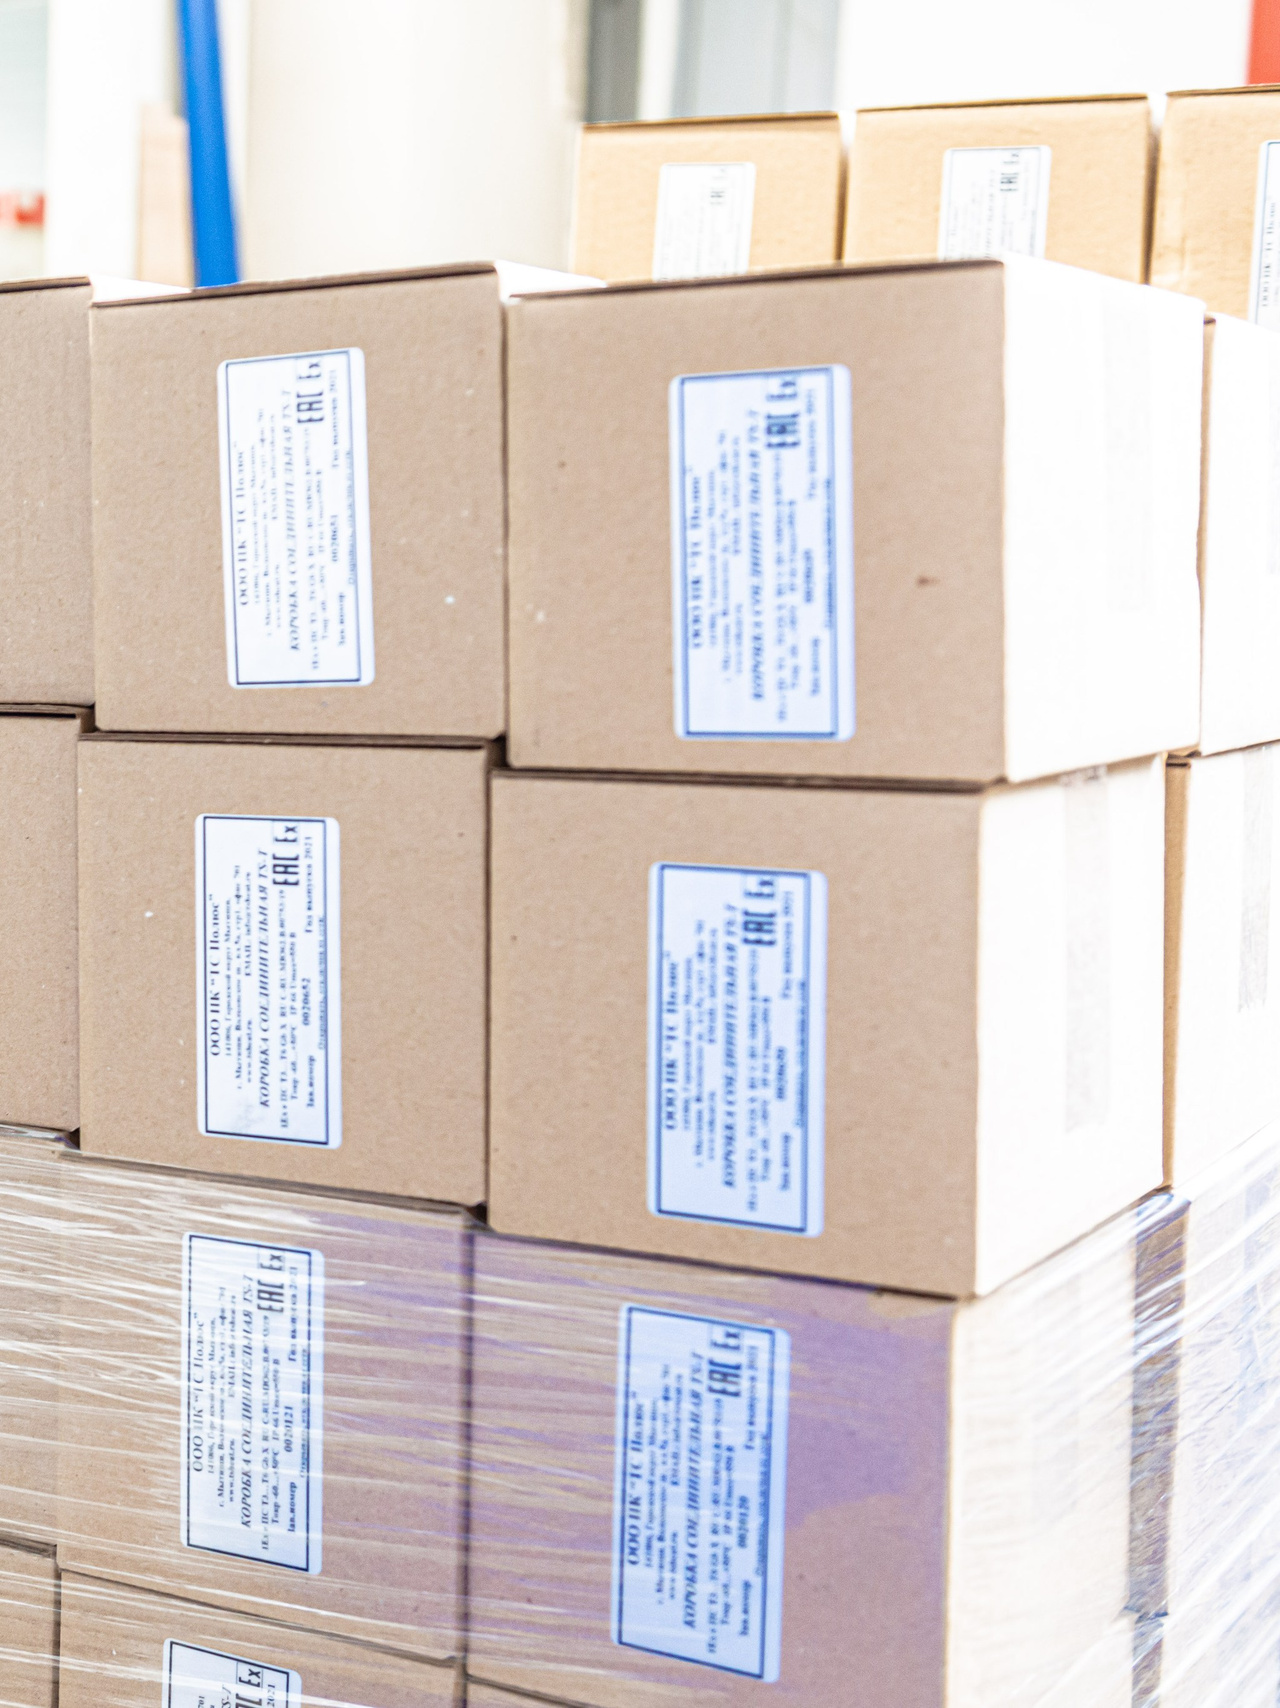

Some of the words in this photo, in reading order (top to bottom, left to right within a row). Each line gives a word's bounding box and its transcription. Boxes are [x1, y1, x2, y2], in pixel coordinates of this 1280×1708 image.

[274, 824, 296, 842] Ex
[271, 852, 299, 885] EAC
[238, 1668, 261, 1687] Ex
